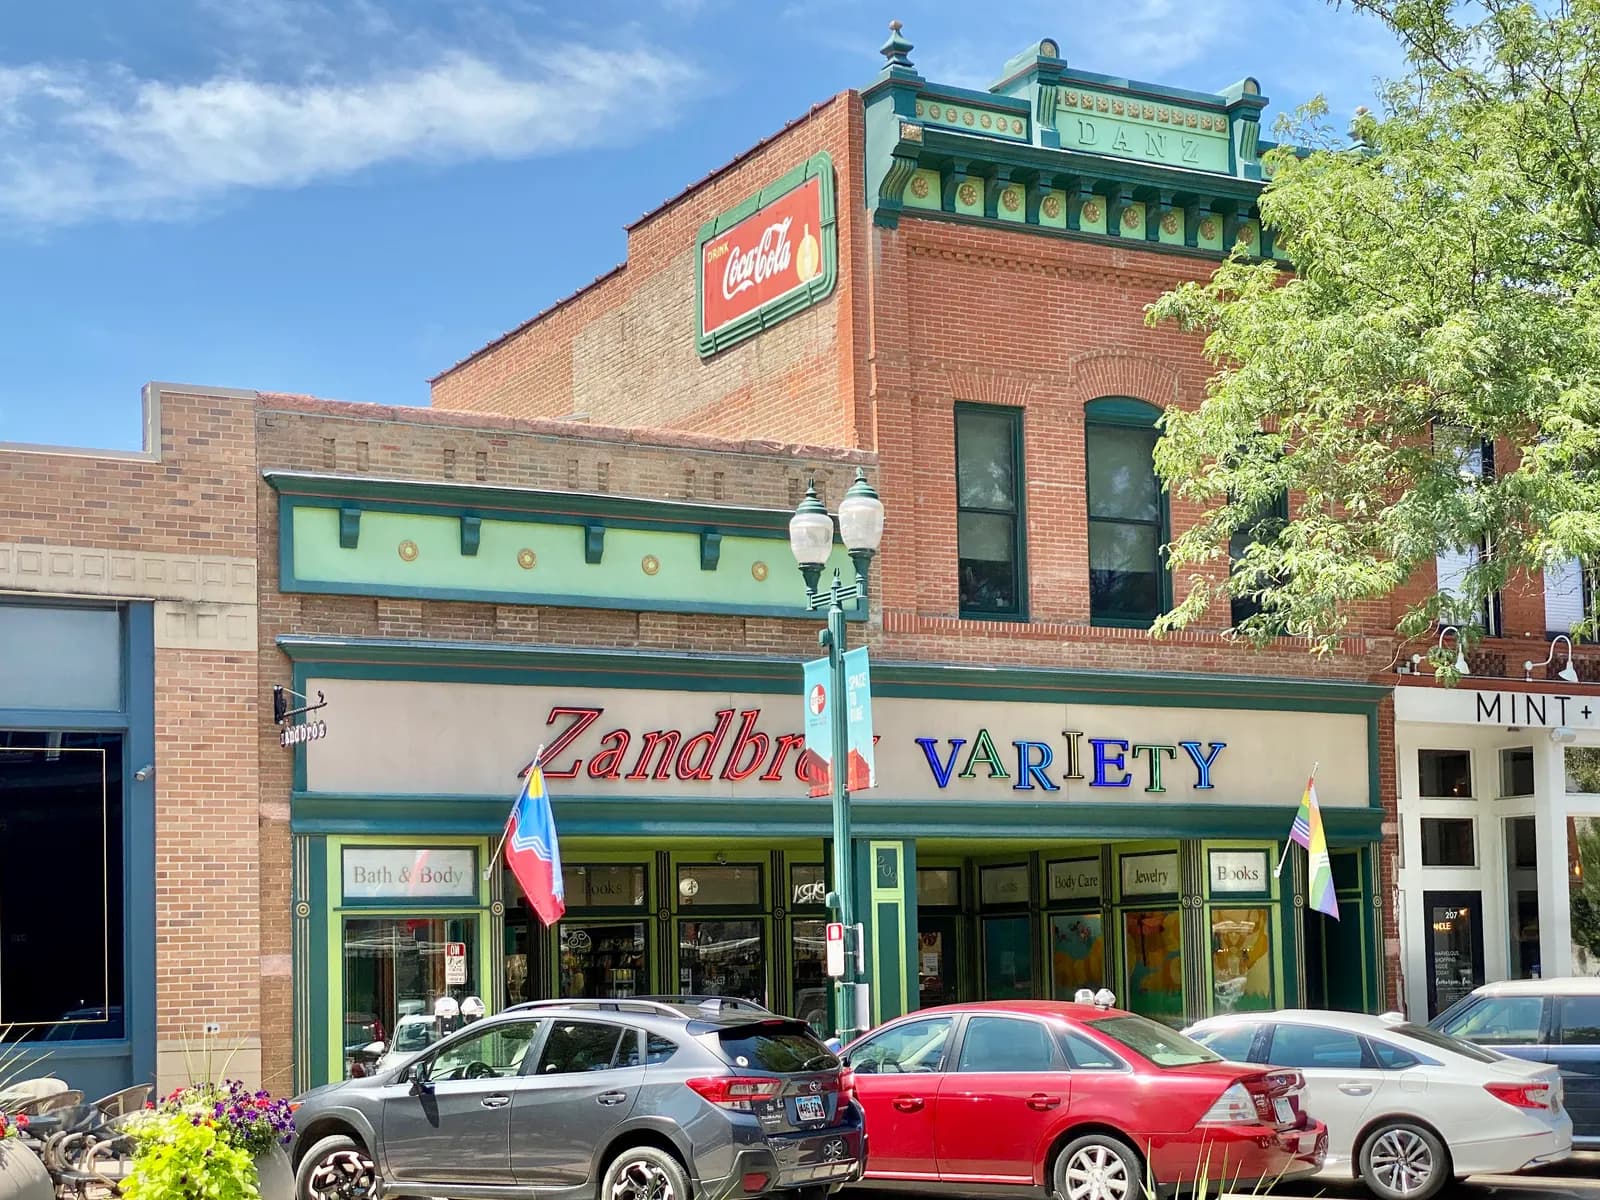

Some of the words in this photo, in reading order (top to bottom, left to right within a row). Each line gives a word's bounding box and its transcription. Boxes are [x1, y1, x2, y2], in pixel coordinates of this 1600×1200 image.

[1078, 119, 1200, 163] DANZ
[707, 241, 729, 263] DRINK
[848, 672, 867, 691] SPACE
[518, 706, 881, 782] Zandbr
[914, 728, 1227, 793] VARIETY
[354, 865, 392, 884] Bath
[398, 866, 411, 884] &
[420, 866, 463, 888] Body
[1055, 873, 1076, 892] Body
[1079, 873, 1098, 888] Care
[1134, 868, 1169, 887] Jewelry
[1217, 865, 1260, 881] Books
[585, 879, 623, 897] ooks
[1445, 911, 1458, 920] 207
